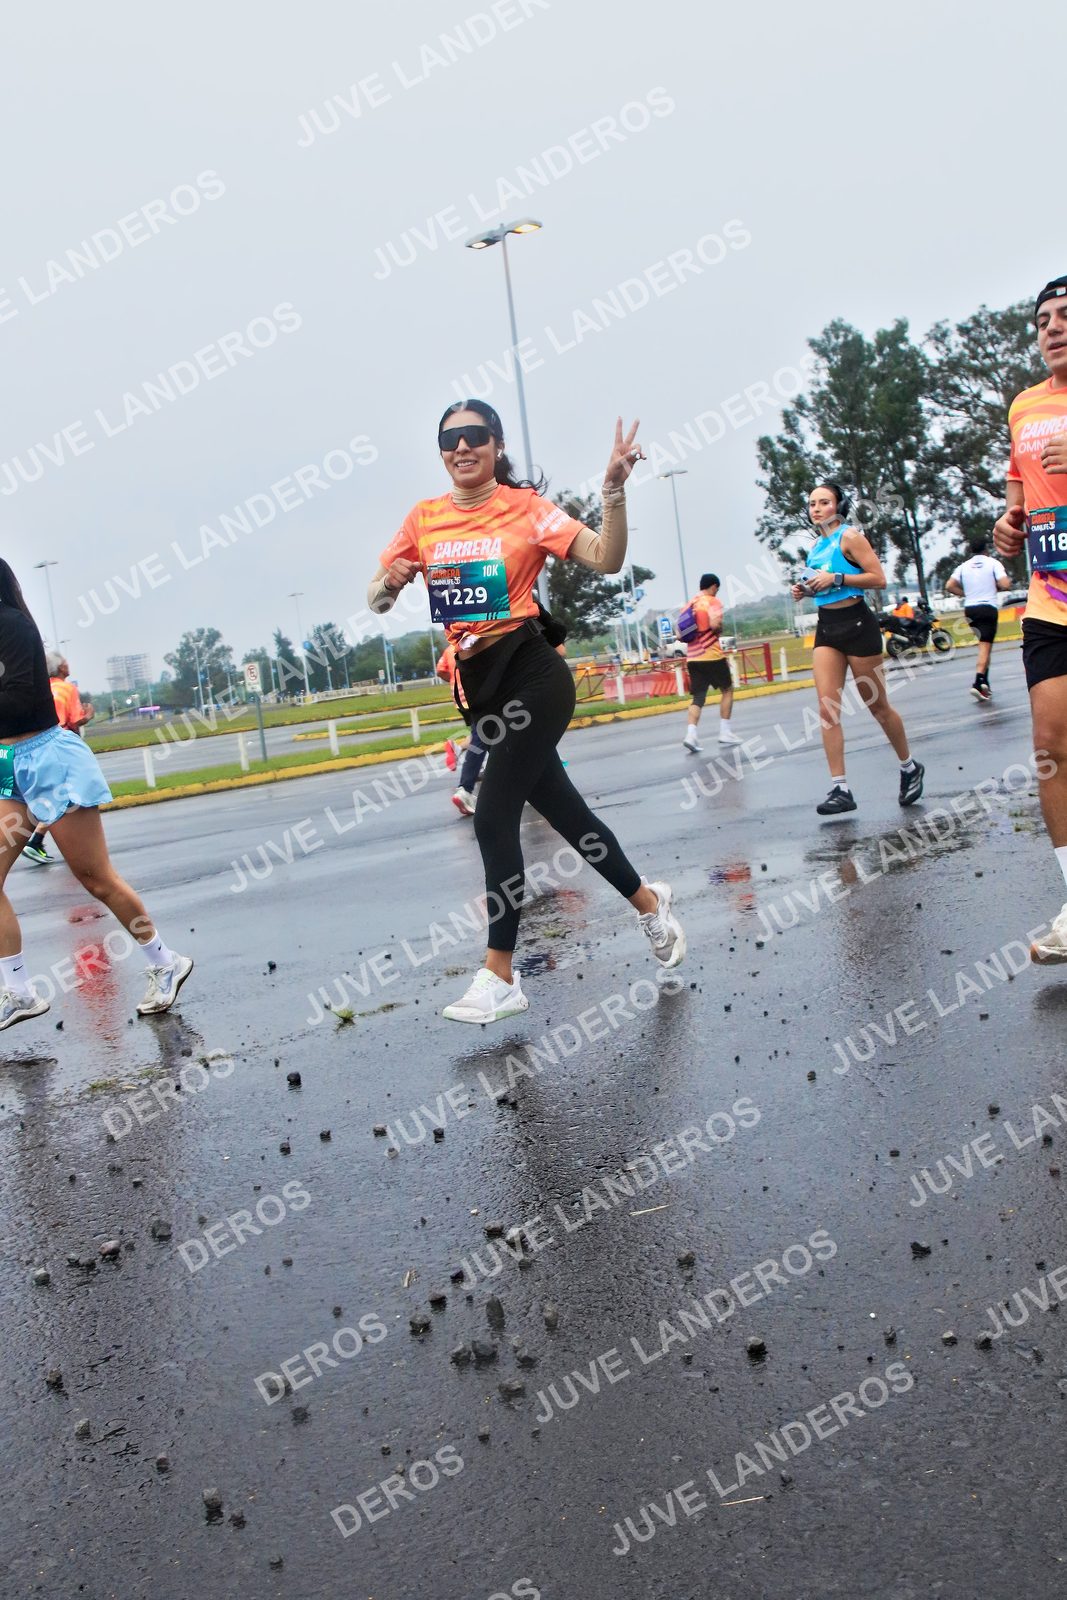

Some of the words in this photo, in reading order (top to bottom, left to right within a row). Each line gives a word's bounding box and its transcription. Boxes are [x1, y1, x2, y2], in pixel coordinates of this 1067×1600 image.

[433, 537, 503, 560] CARRERA
[1039, 532, 1067, 552] 118
[483, 563, 499, 577] 10K
[441, 586, 488, 606] 1229
